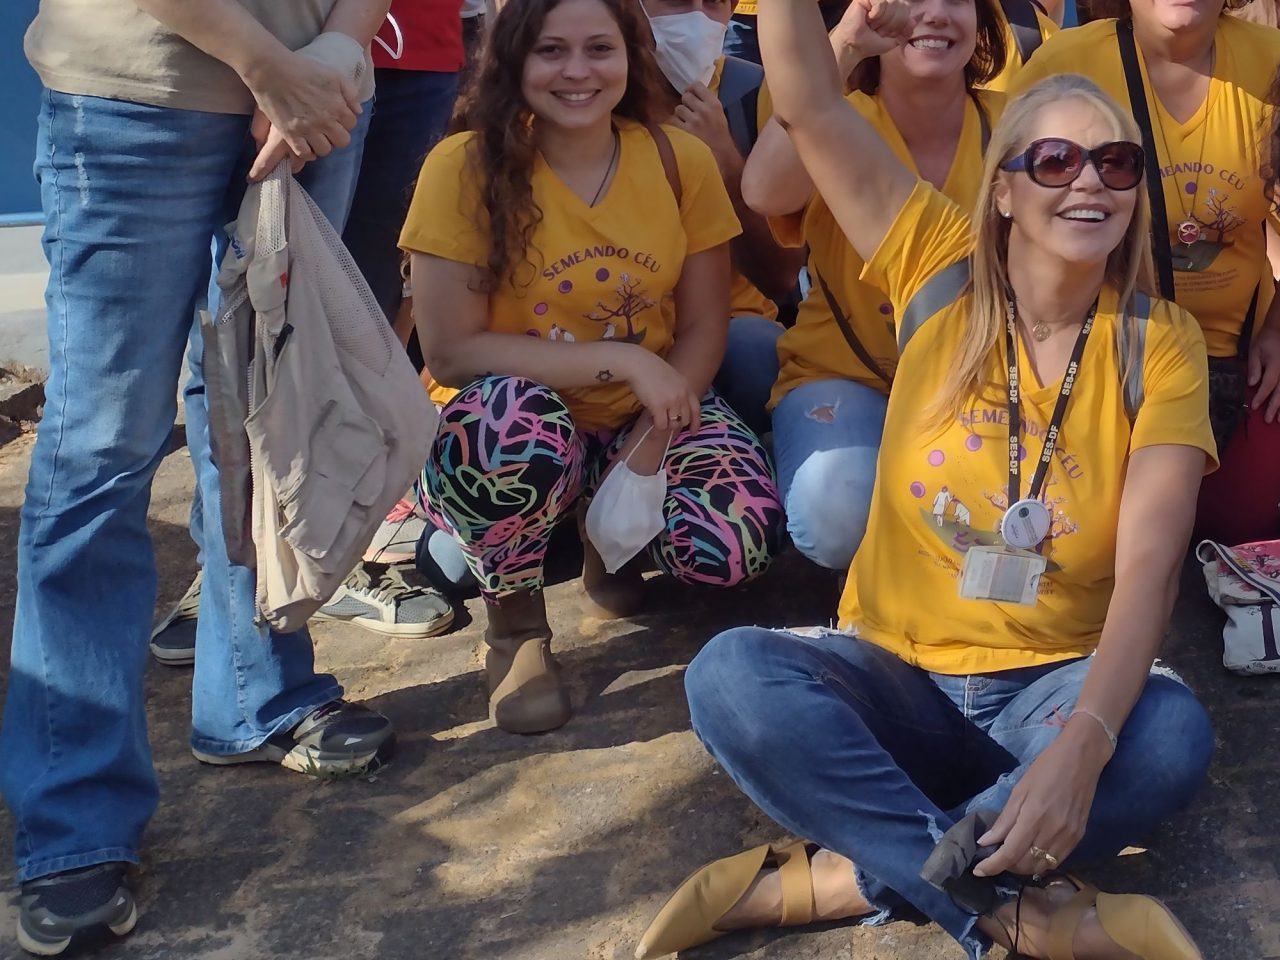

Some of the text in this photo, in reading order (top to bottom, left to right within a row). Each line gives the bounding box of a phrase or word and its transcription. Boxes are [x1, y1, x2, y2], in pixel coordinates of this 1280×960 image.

[1219, 169, 1245, 191] CÉU
[542, 245, 662, 281] SEMEANDO CÉU
[1009, 366, 1018, 404] SES-DF
[1061, 361, 1079, 396] SES-DF
[1009, 435, 1018, 475] SES-DF
[1041, 424, 1059, 463] SES-DF
[1055, 447, 1085, 480] CÉU
